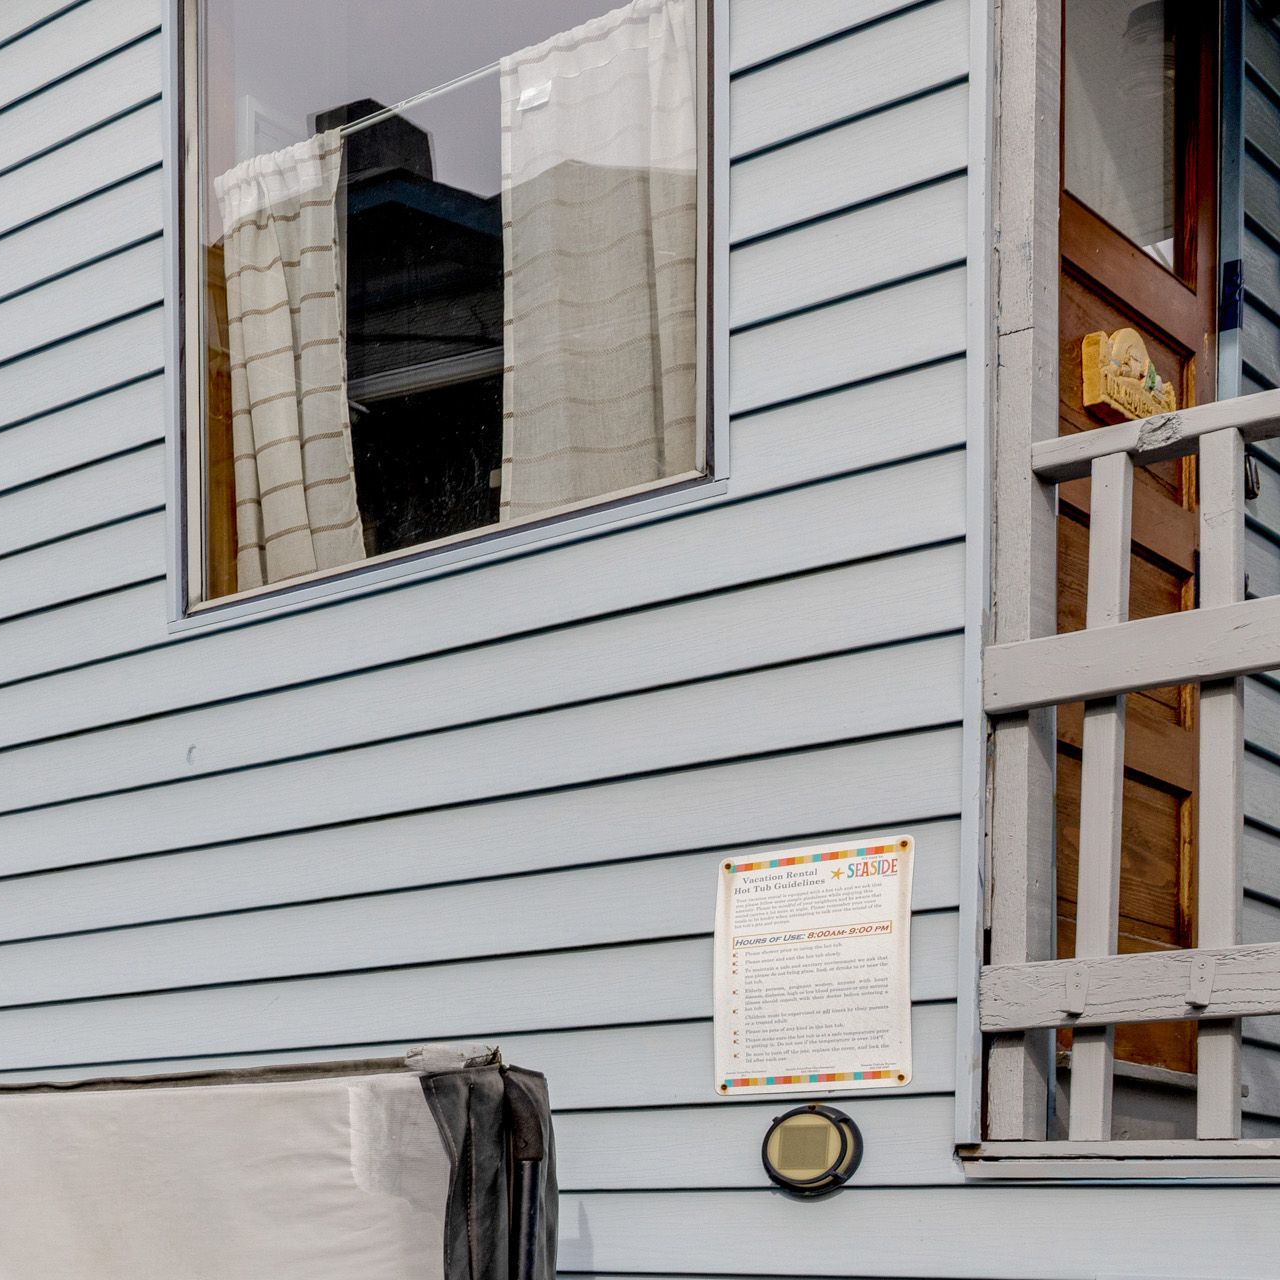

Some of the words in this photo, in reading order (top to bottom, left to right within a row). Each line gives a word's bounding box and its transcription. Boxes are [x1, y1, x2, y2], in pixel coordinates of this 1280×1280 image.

[848, 858, 898, 878] SEASIDE
[743, 873, 783, 884] Vacation
[787, 869, 817, 879] Rental
[735, 887, 750, 895] Hot
[754, 884, 771, 892] Tub
[775, 877, 825, 890] Guidelines
[849, 926, 873, 935] 9:00
